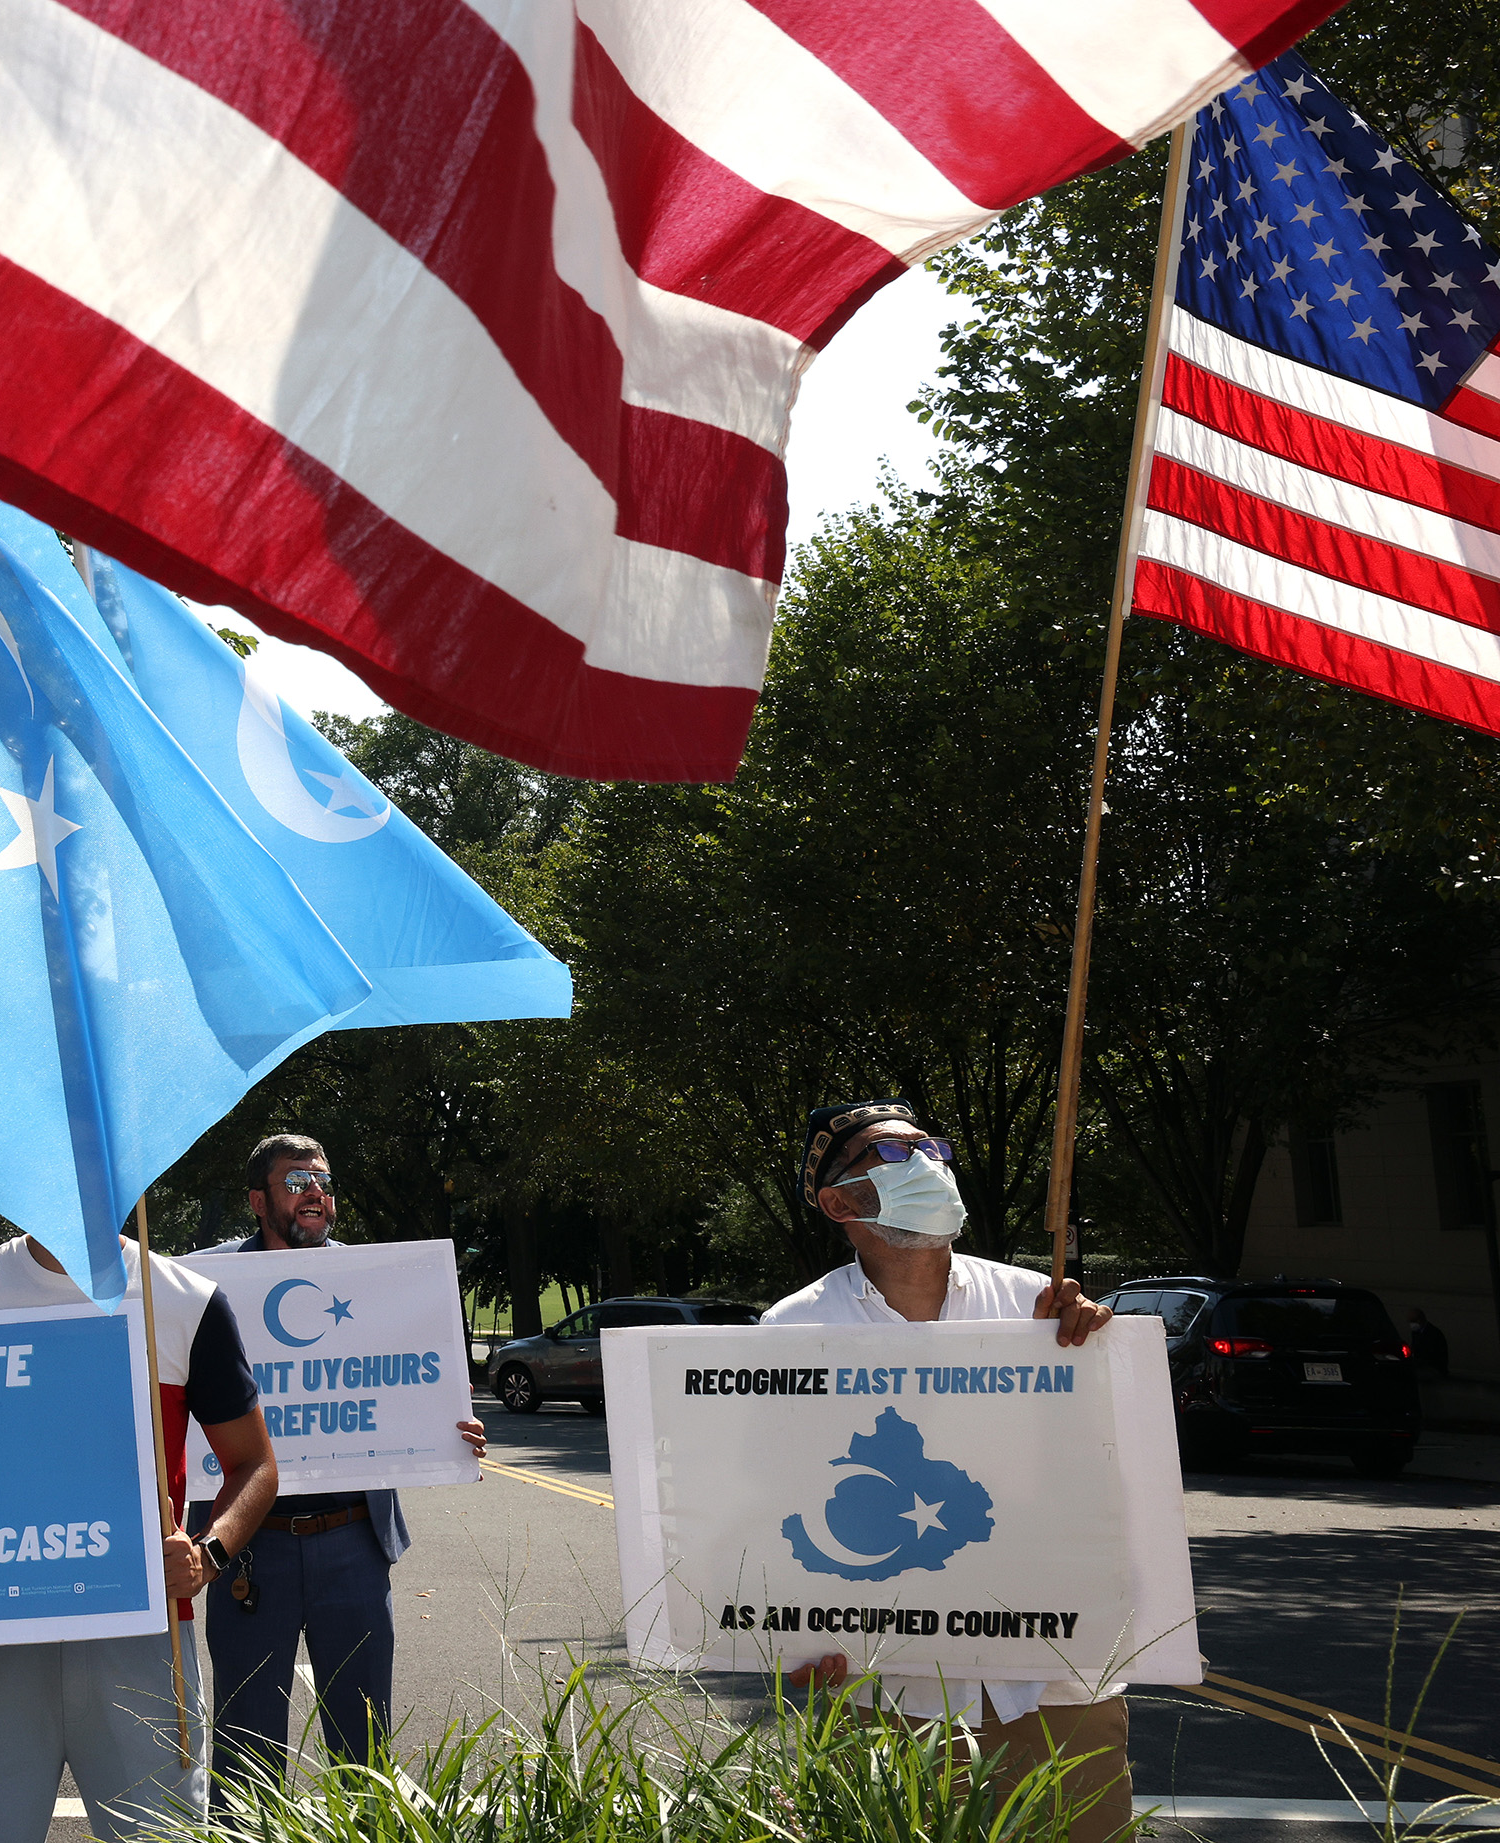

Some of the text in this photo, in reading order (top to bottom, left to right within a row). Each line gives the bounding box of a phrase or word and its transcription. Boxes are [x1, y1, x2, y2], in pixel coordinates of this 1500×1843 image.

[302, 1351, 441, 1392] UYGHURS
[685, 1365, 1073, 1395] RECOGNIZE EAST TURKISTAN
[264, 1399, 377, 1438] REFUGE
[719, 1604, 1079, 1639] AS AN OCCUPIED COUNTRY
